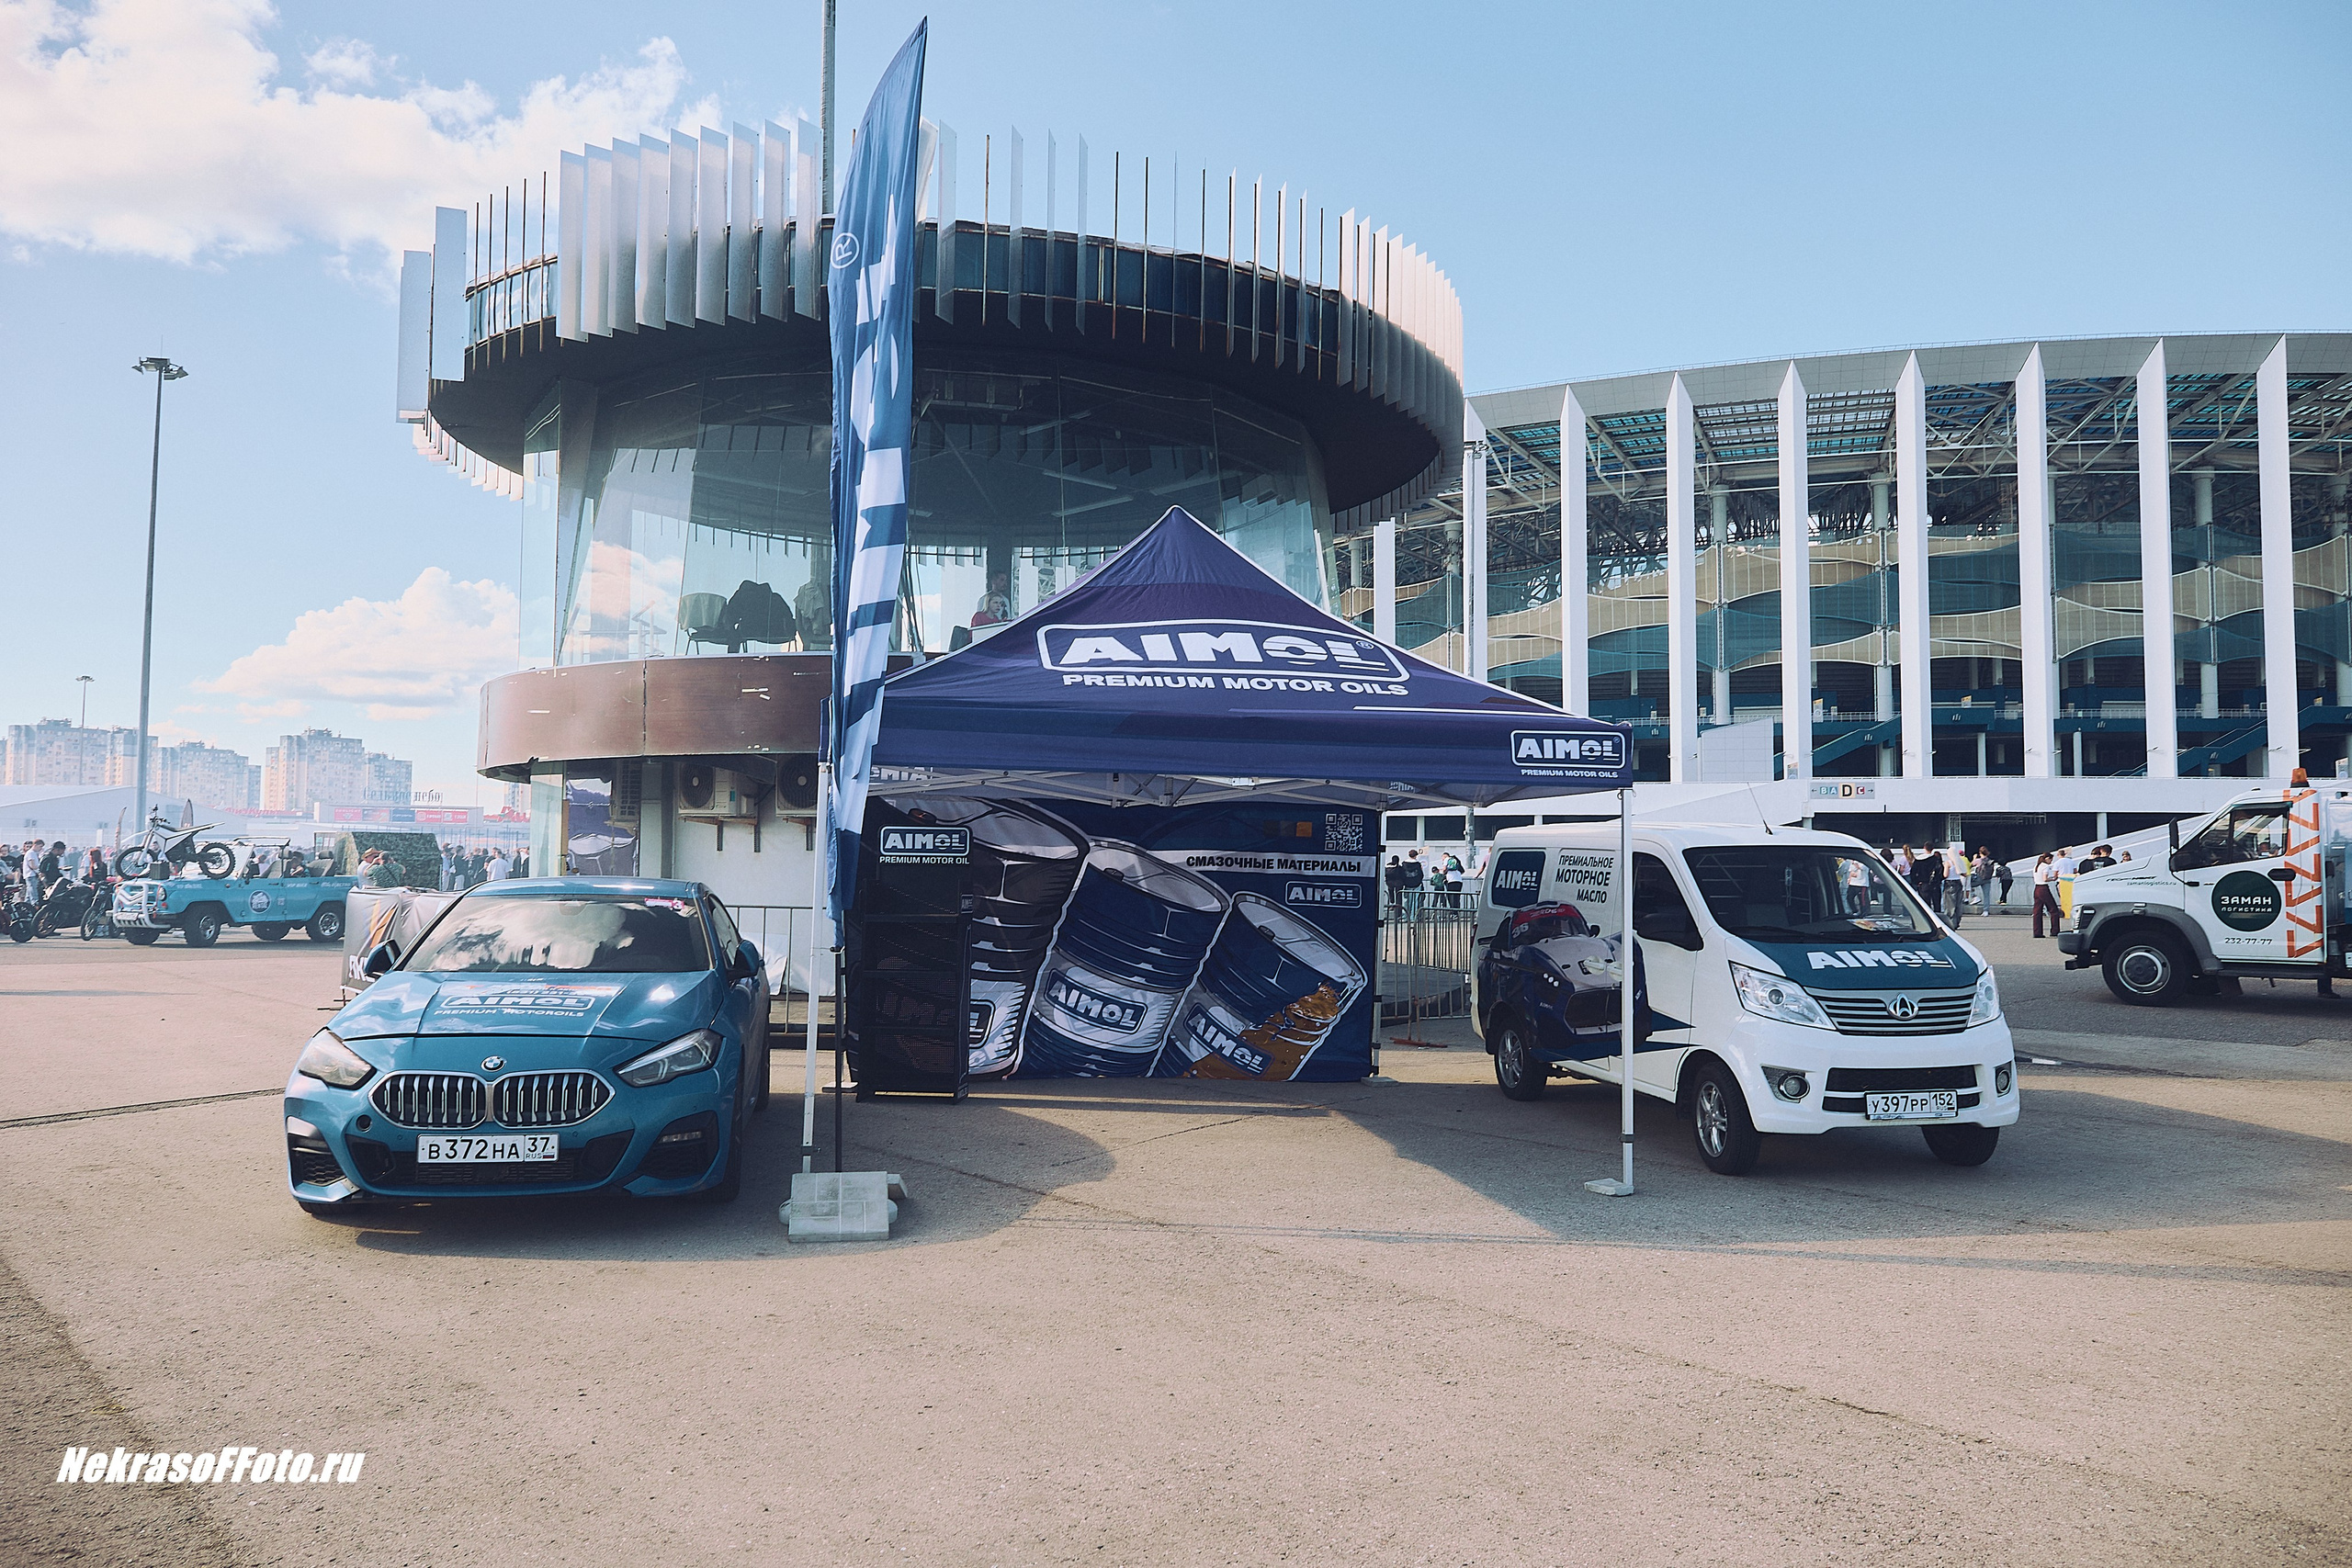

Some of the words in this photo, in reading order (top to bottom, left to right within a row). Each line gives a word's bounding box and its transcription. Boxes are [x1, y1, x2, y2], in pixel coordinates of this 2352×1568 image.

[1058, 632, 1390, 671] AIMOL
[1062, 674, 1216, 689] PREMIUM
[1224, 677, 1336, 693] MOTOR
[1345, 682, 1409, 695] OILS
[1517, 738, 1620, 761] AIMOL
[1565, 770, 1598, 778] MOTOR
[1841, 784, 1853, 797] D
[1857, 786, 1865, 795] C
[884, 832, 965, 850] AIMOL
[1186, 856, 1274, 870] СМАЗОЧНЫЕ
[1277, 858, 1362, 873] МАТЕРИАЛЫ
[1558, 854, 1614, 869] ПРЕМИАЛЬНОЕ
[1495, 870, 1538, 891] AIMOL
[1555, 868, 1611, 887] МОТОРНОЕ
[1288, 886, 1358, 903] AIMOL
[1577, 888, 1608, 903] МАСЛО
[2221, 896, 2272, 905] ЗАМАН
[2224, 937, 2272, 945] 232-77-77
[1806, 950, 1952, 970] AIMOL
[447, 996, 585, 1007] AIMOL
[1048, 980, 1137, 1027] AIMOL
[1188, 1012, 1263, 1074] AIMOL
[1931, 1092, 1953, 1106] 152
[527, 1136, 550, 1153] 37
